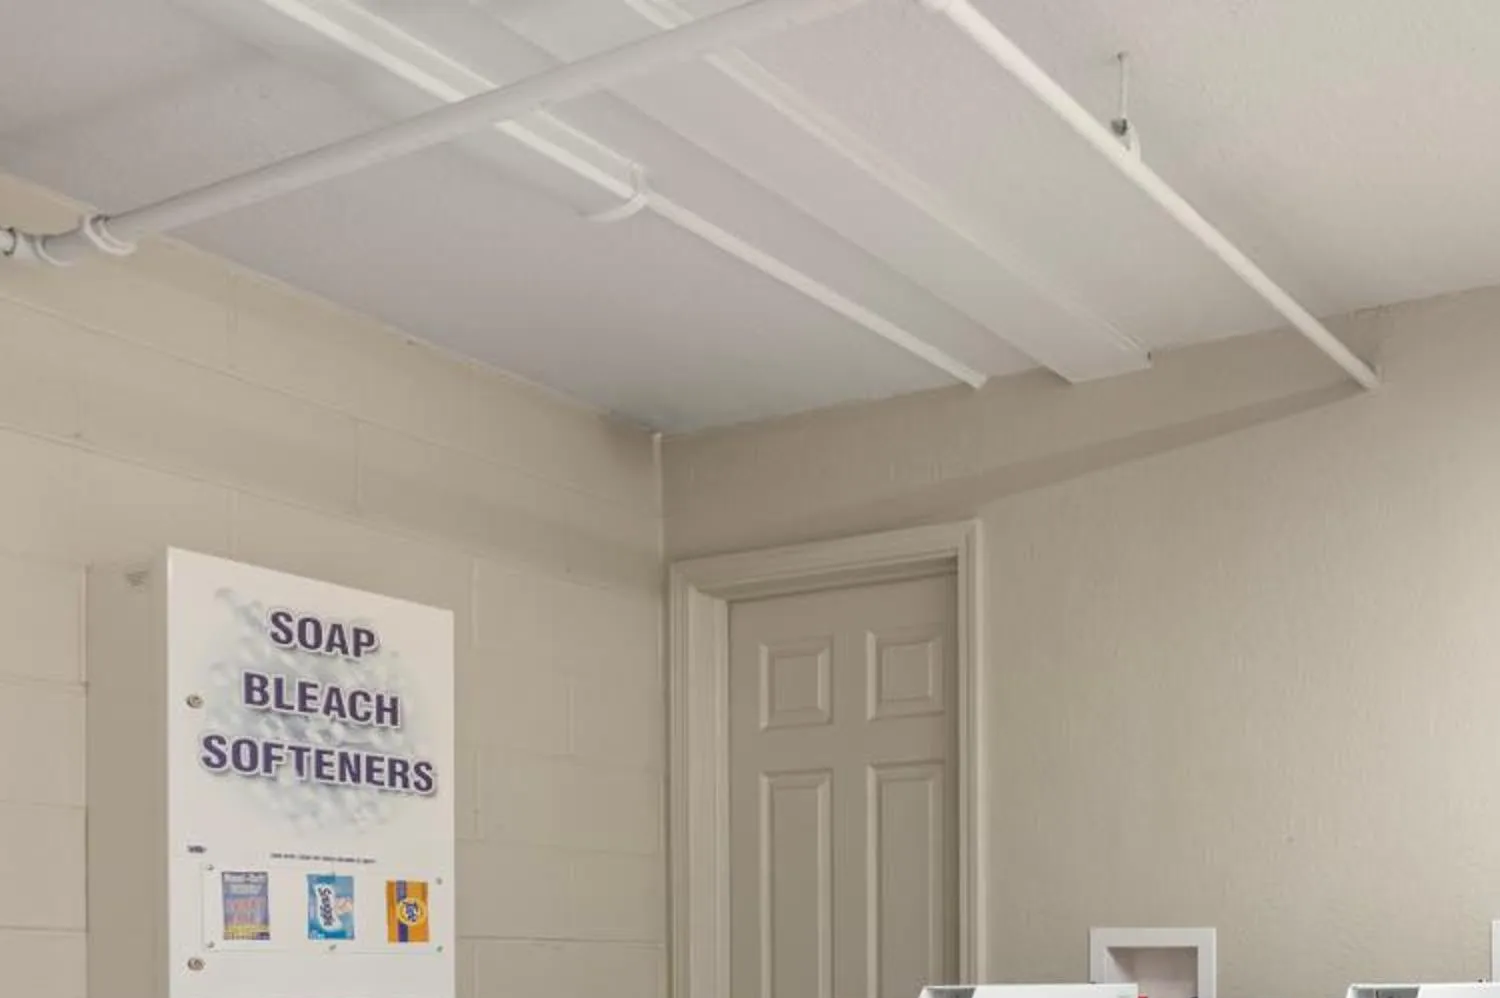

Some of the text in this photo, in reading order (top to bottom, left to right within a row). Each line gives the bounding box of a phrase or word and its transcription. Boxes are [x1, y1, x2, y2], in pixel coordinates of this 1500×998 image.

[269, 610, 377, 659] SOAP
[242, 671, 400, 727] BLEACH
[201, 733, 434, 793] SOFTENERS
